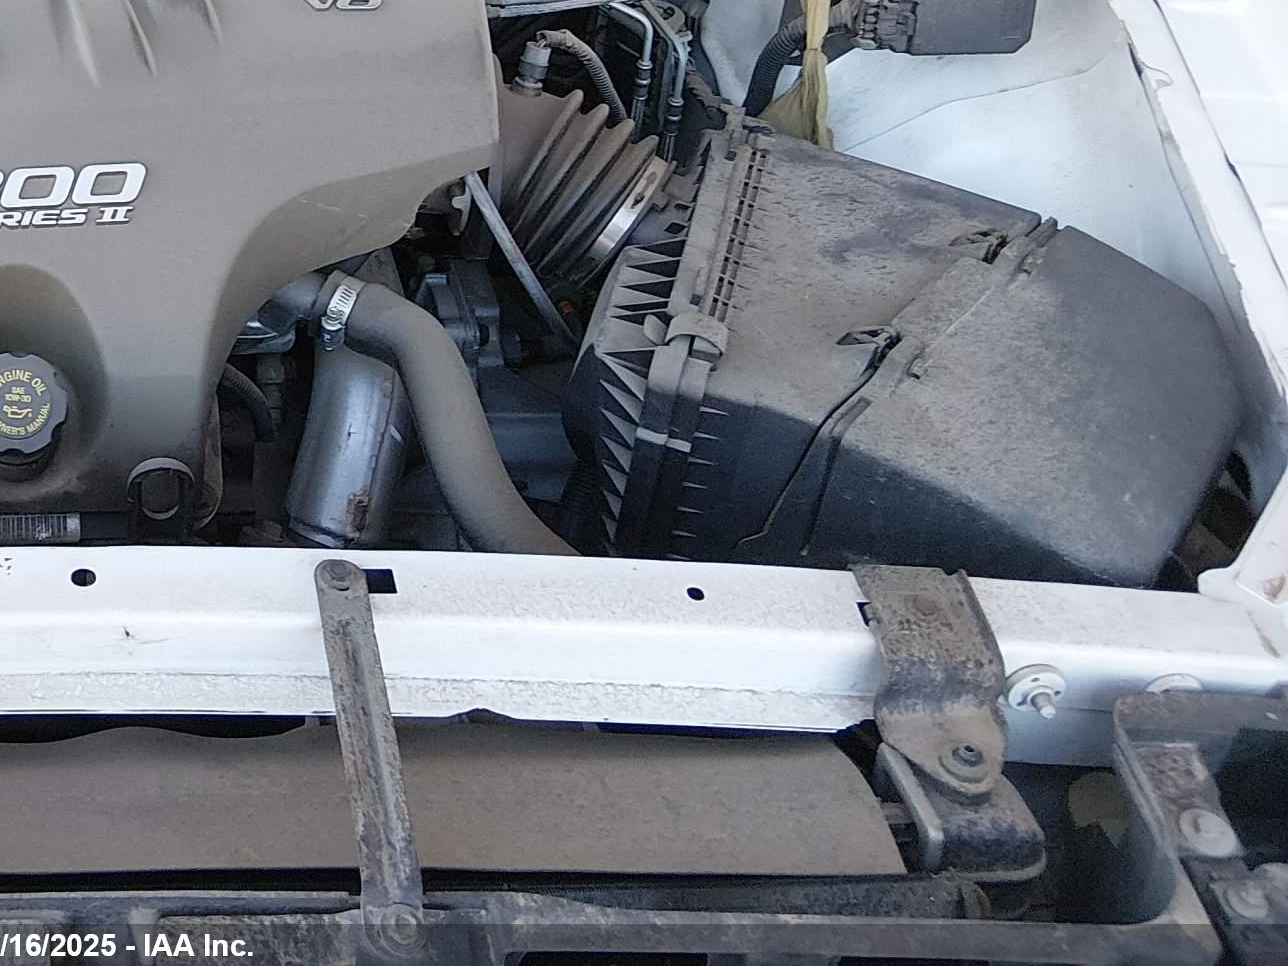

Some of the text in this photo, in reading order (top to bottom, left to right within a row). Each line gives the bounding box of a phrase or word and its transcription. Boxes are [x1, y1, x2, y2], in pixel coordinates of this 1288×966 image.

[95, 205, 135, 226] II
[31, 378, 47, 396] OIL
[5, 393, 32, 403] 10W-30
[27, 403, 51, 433] MANUAL
